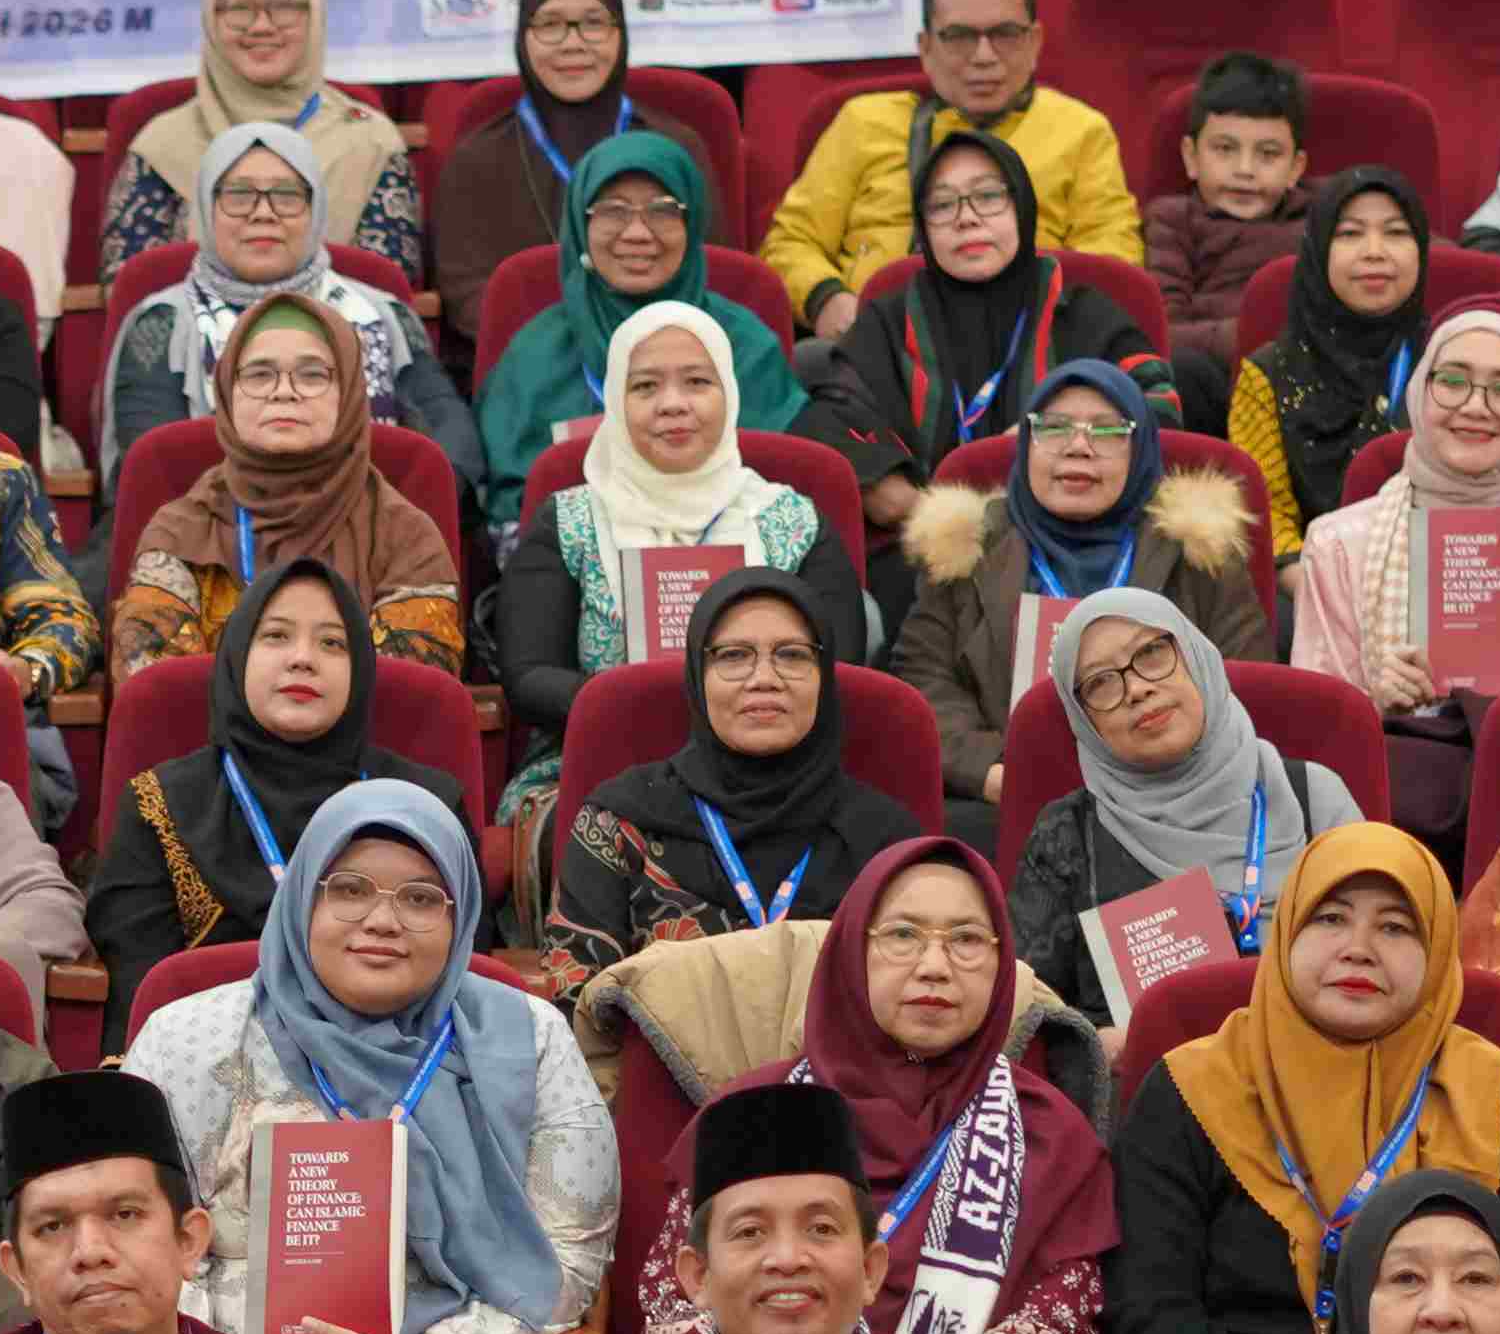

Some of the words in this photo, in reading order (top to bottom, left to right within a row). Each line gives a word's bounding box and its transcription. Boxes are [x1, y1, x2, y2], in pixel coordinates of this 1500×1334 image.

[19, 7, 113, 37] 2026
[123, 6, 155, 33] M
[957, 1053, 1012, 1231] AZ-ZAHR
[288, 1151, 350, 1165] TOWARDS
[288, 1166, 299, 1178] A
[300, 1165, 328, 1178] NEW
[287, 1178, 338, 1192] THEORY
[287, 1193, 305, 1206] OF
[286, 1207, 314, 1219] CAN
[315, 1205, 368, 1219] ISLAMIC
[286, 1219, 341, 1233] FINANCE
[285, 1234, 301, 1246] BE
[302, 1233, 321, 1246] IT?
